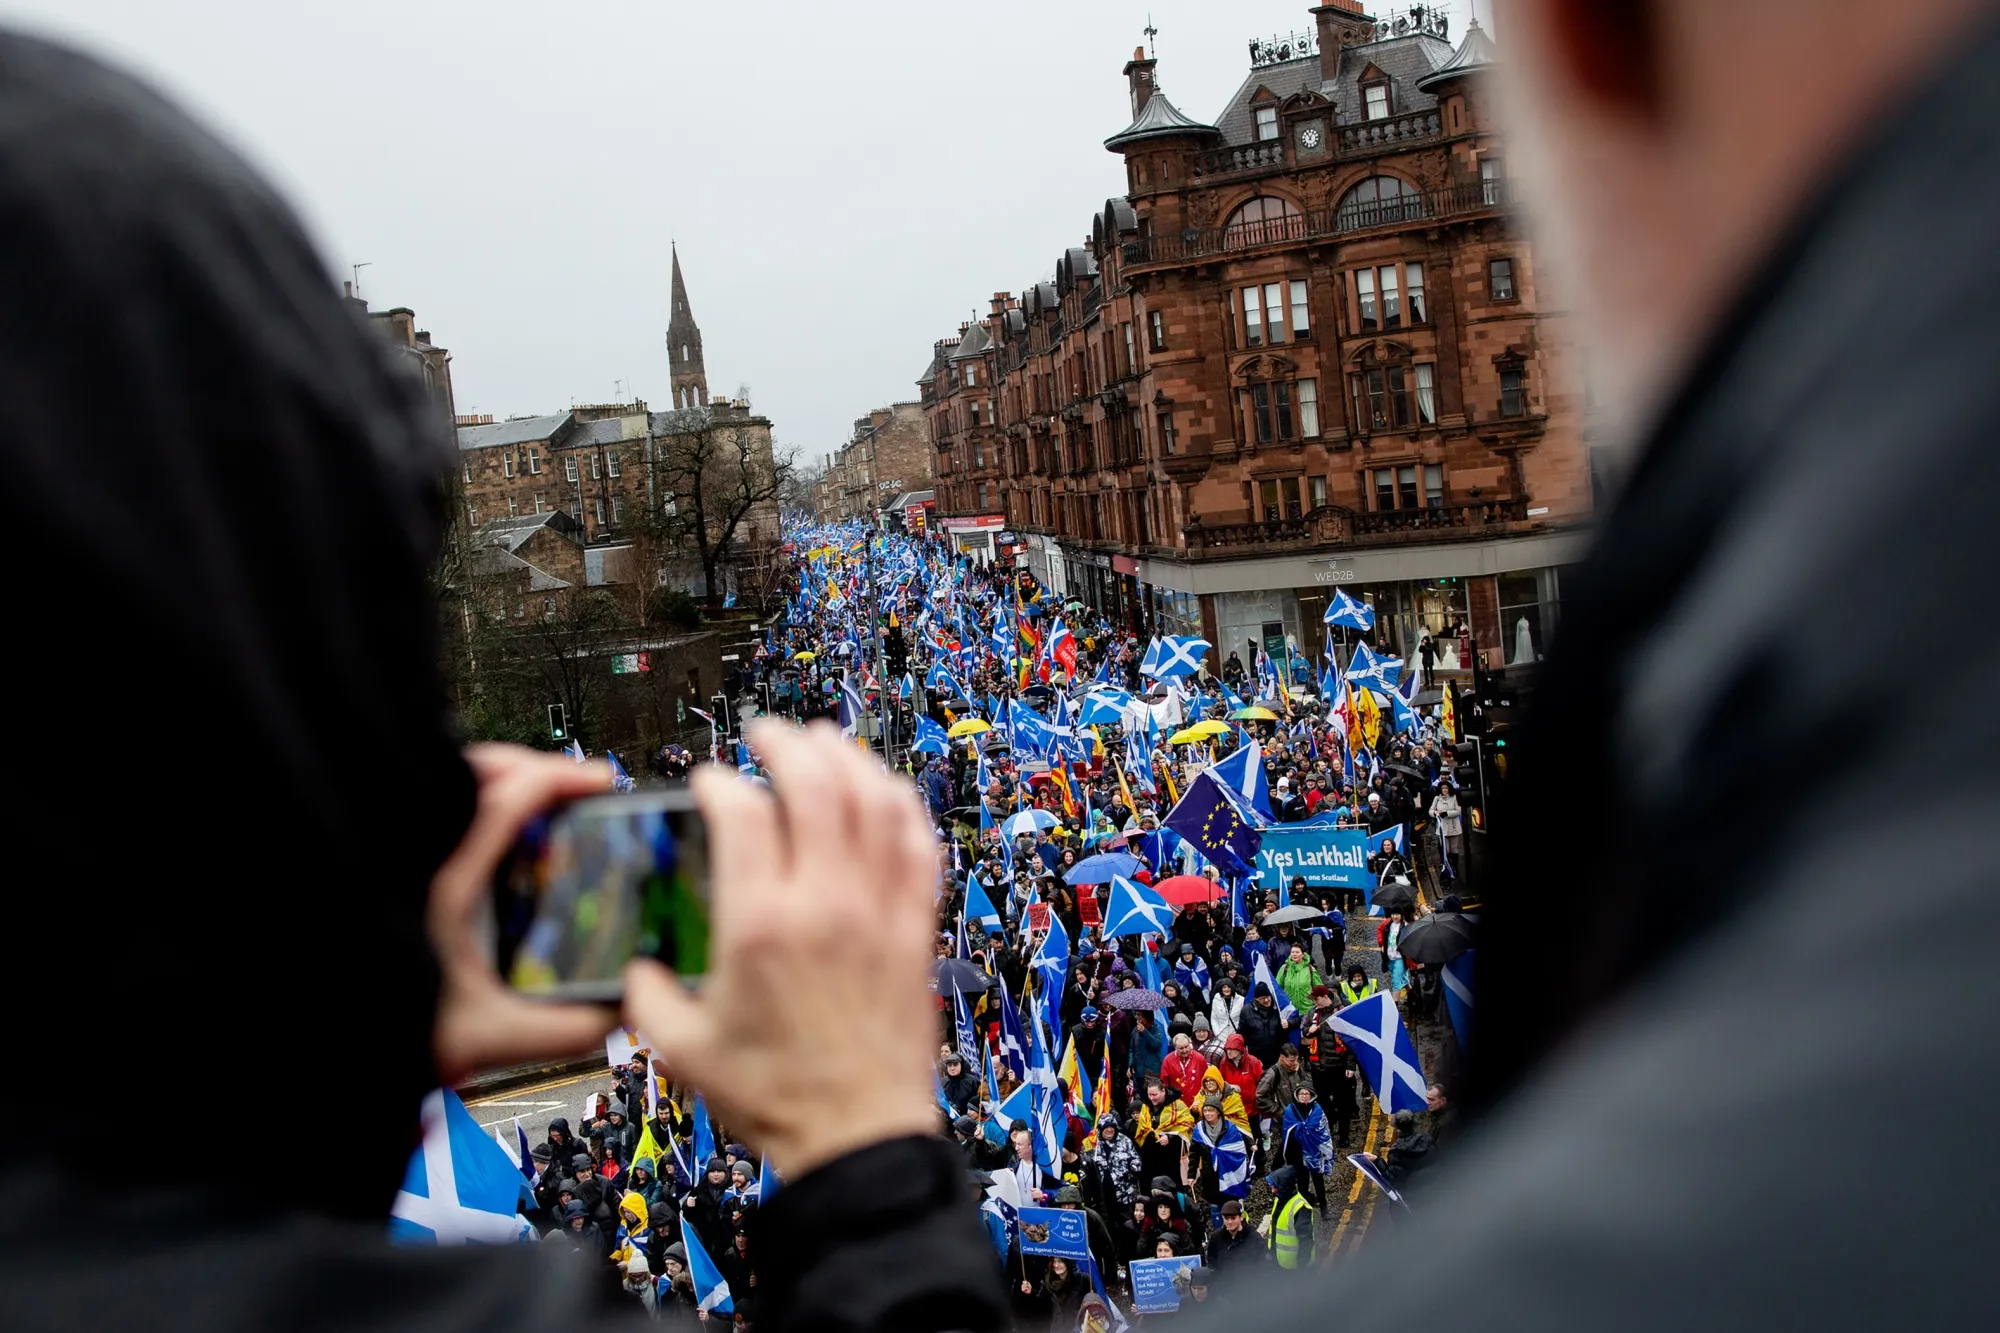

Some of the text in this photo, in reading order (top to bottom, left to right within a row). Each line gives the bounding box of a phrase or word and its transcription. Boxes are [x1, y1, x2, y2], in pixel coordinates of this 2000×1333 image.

[1314, 570, 1354, 582] WED2B
[1262, 844, 1364, 868] Yes Larkhall
[1321, 874, 1349, 882] Scotland
[1053, 1248, 1086, 1256] Conservatives
